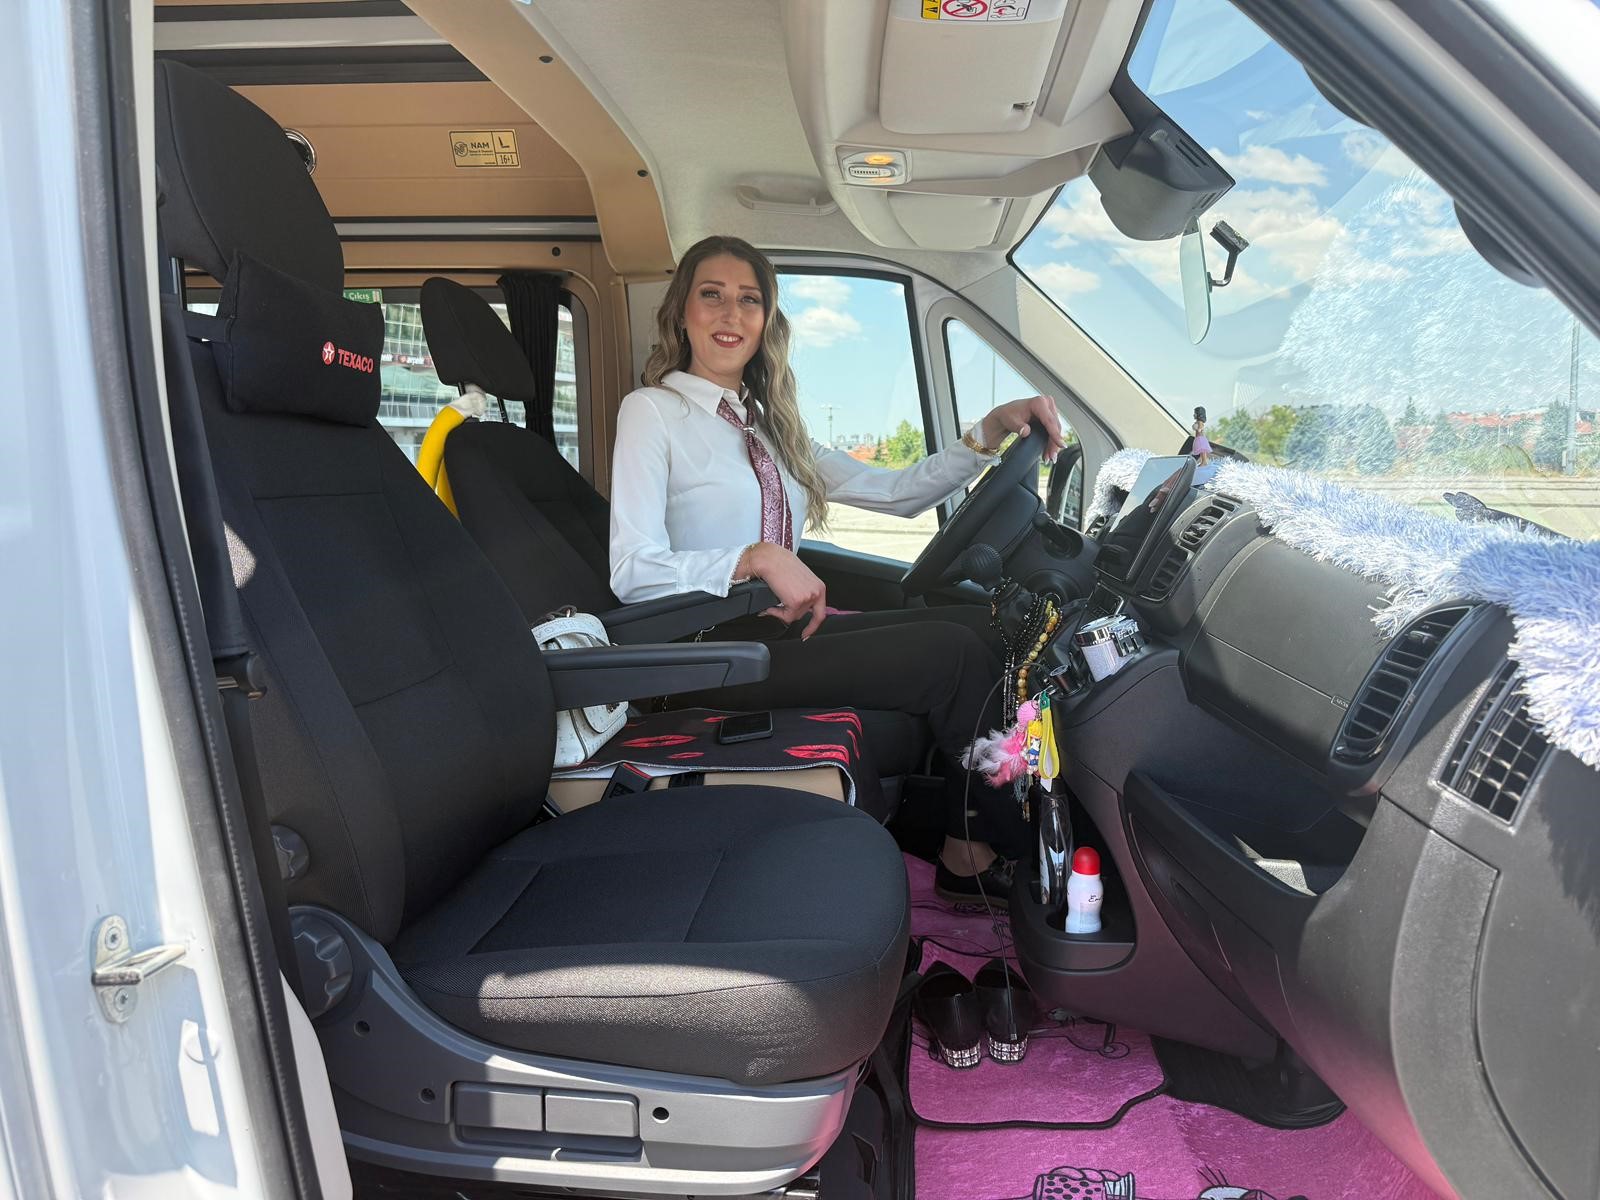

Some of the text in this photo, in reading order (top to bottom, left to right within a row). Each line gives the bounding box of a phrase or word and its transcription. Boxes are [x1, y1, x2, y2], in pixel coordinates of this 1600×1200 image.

[498, 136, 510, 148] L
[500, 154, 515, 165] 16+1
[338, 348, 374, 374] TEXACO
